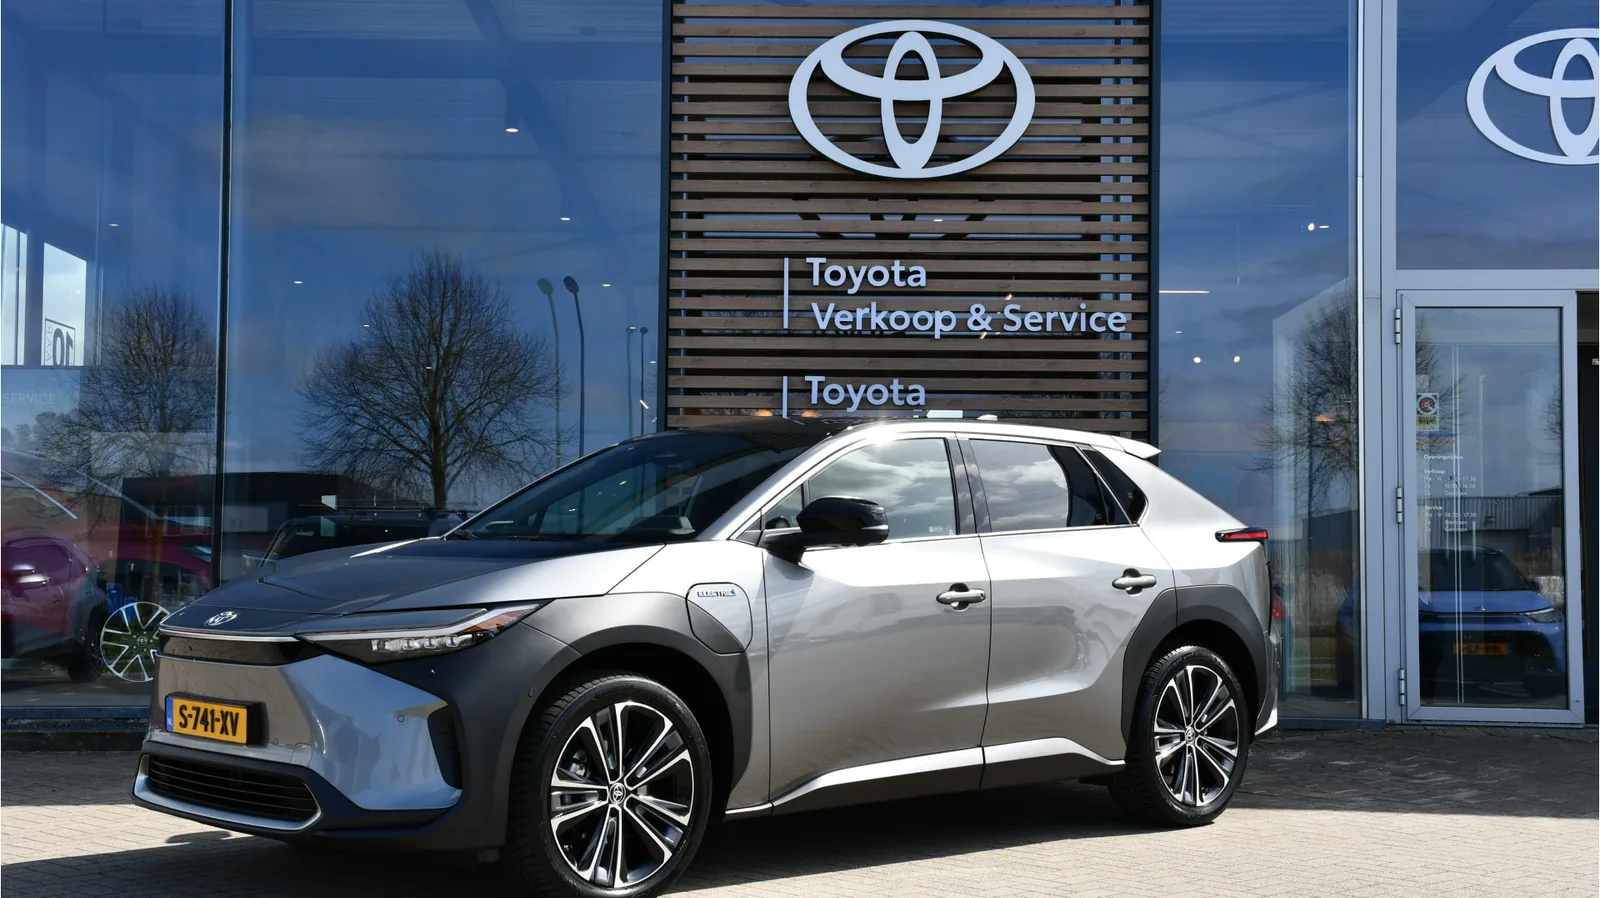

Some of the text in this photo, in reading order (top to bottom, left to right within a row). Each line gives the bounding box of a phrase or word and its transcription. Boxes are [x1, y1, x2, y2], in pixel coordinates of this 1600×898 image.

[805, 257, 927, 294] Toyota
[811, 301, 1127, 340] Verkoop & Service
[4, 392, 57, 405] SERVICE
[804, 375, 926, 413] Toyota
[178, 704, 240, 737] S-741-XV
